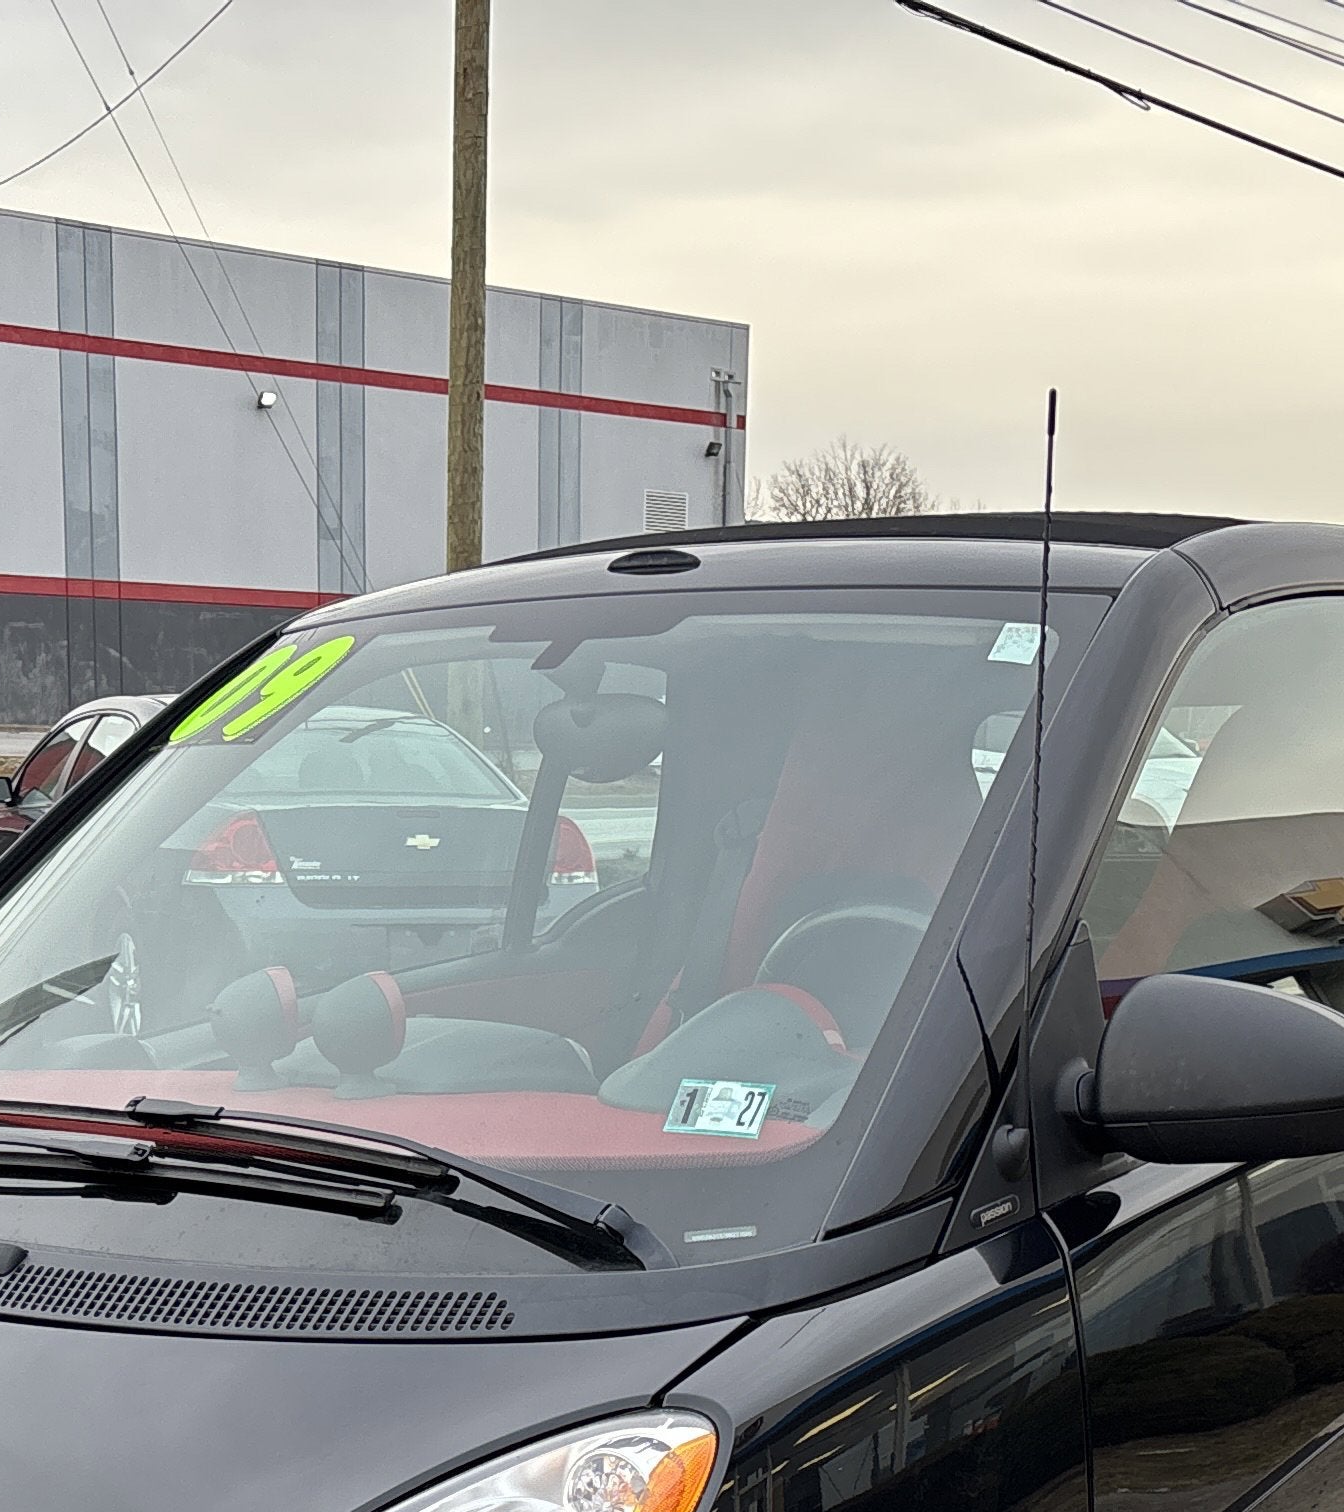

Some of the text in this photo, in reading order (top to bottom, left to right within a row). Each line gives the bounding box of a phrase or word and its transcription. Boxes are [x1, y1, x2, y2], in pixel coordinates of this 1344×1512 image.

[168, 635, 356, 745] 09
[680, 1088, 699, 1124] 1
[735, 1090, 768, 1130] 27
[980, 1202, 1013, 1227] passion
